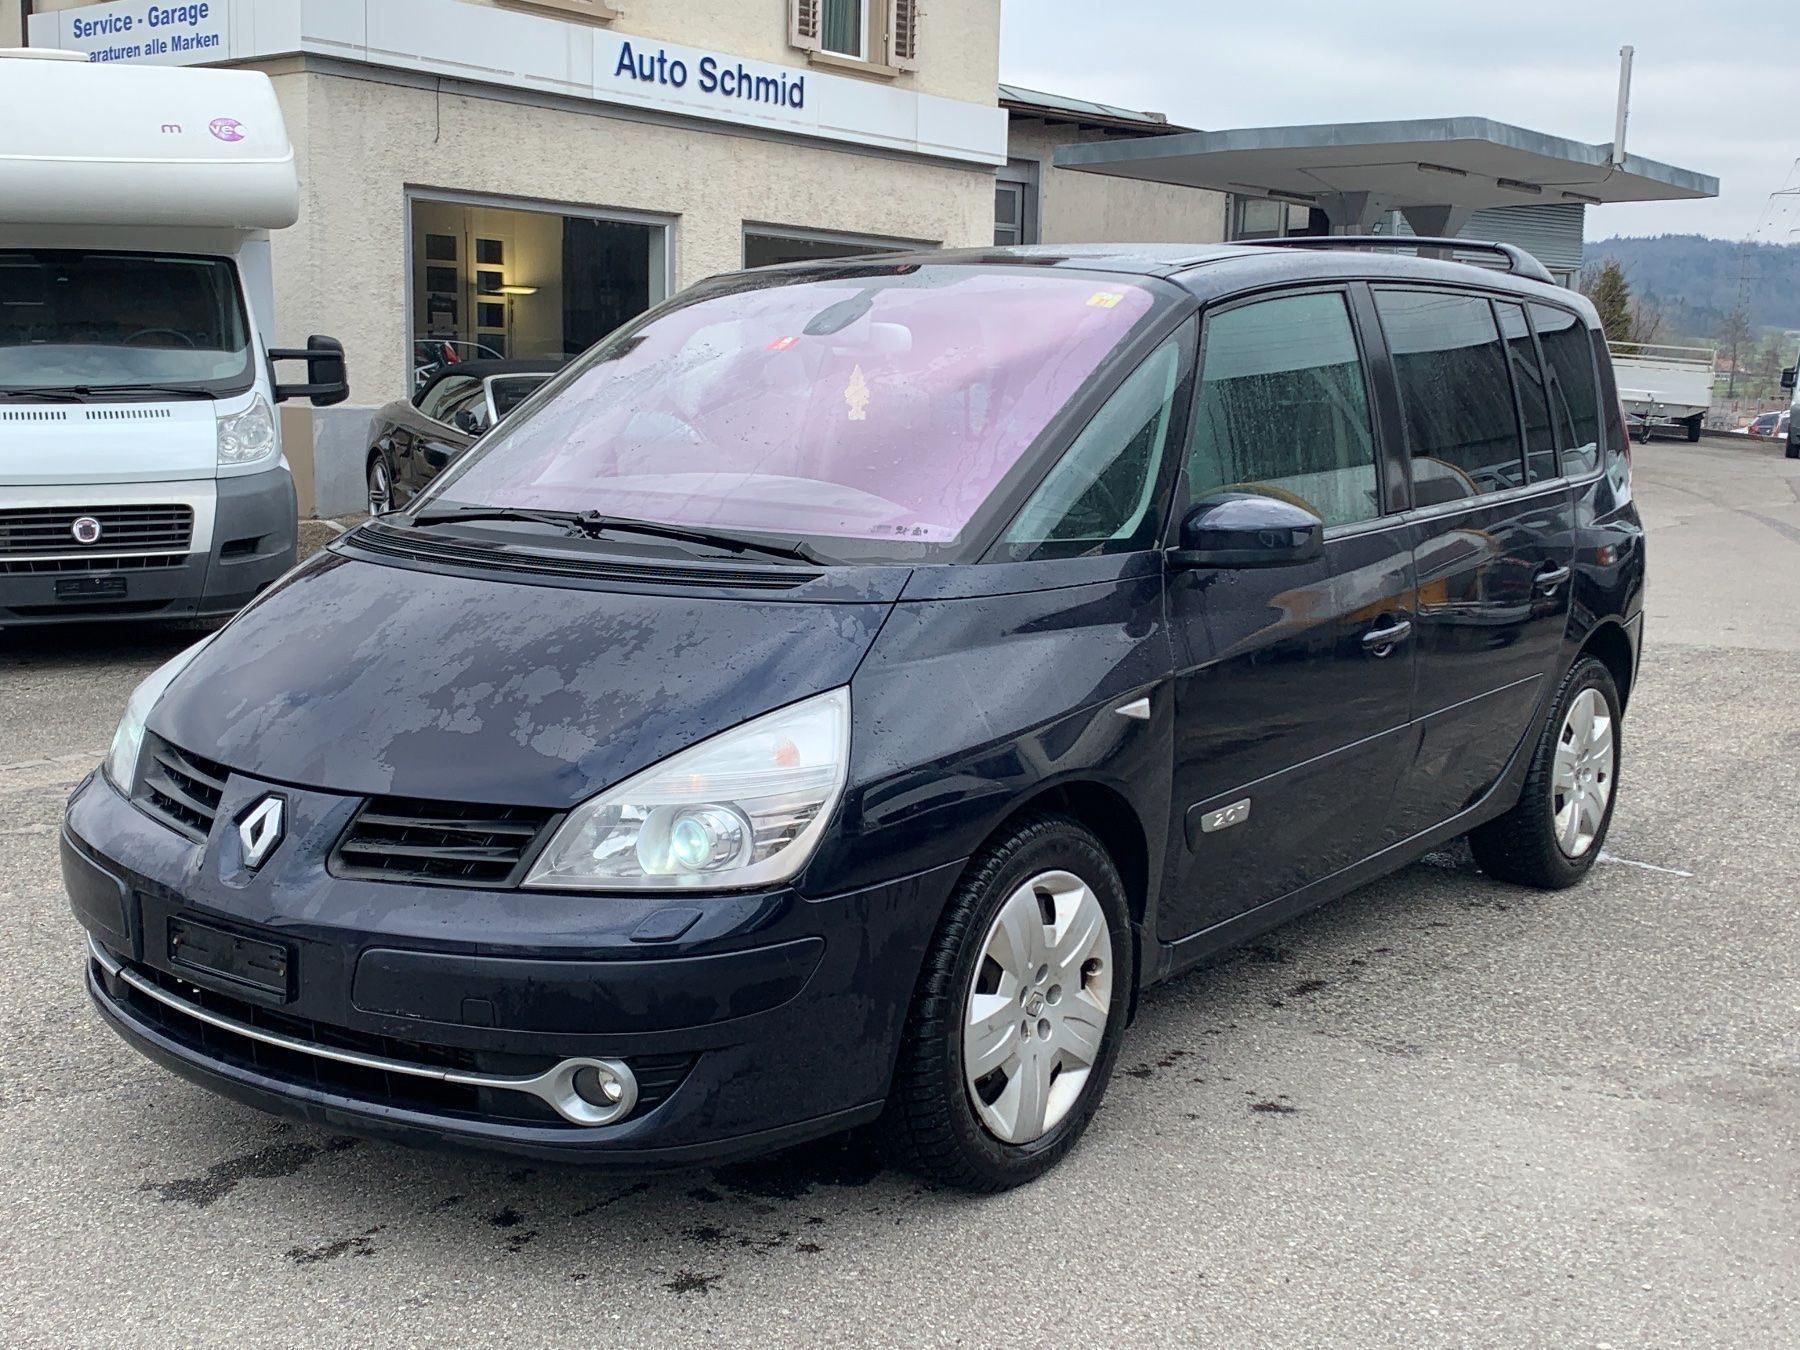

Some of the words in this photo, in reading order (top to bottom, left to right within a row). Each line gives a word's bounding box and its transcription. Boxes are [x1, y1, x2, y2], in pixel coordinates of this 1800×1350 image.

[73, 14, 133, 38] Service
[148, 2, 209, 26] Garage
[90, 46, 141, 62] araturen
[144, 38, 167, 55] alle
[171, 33, 219, 52] Marken
[614, 41, 687, 88] Auto
[699, 56, 805, 109] Schmid
